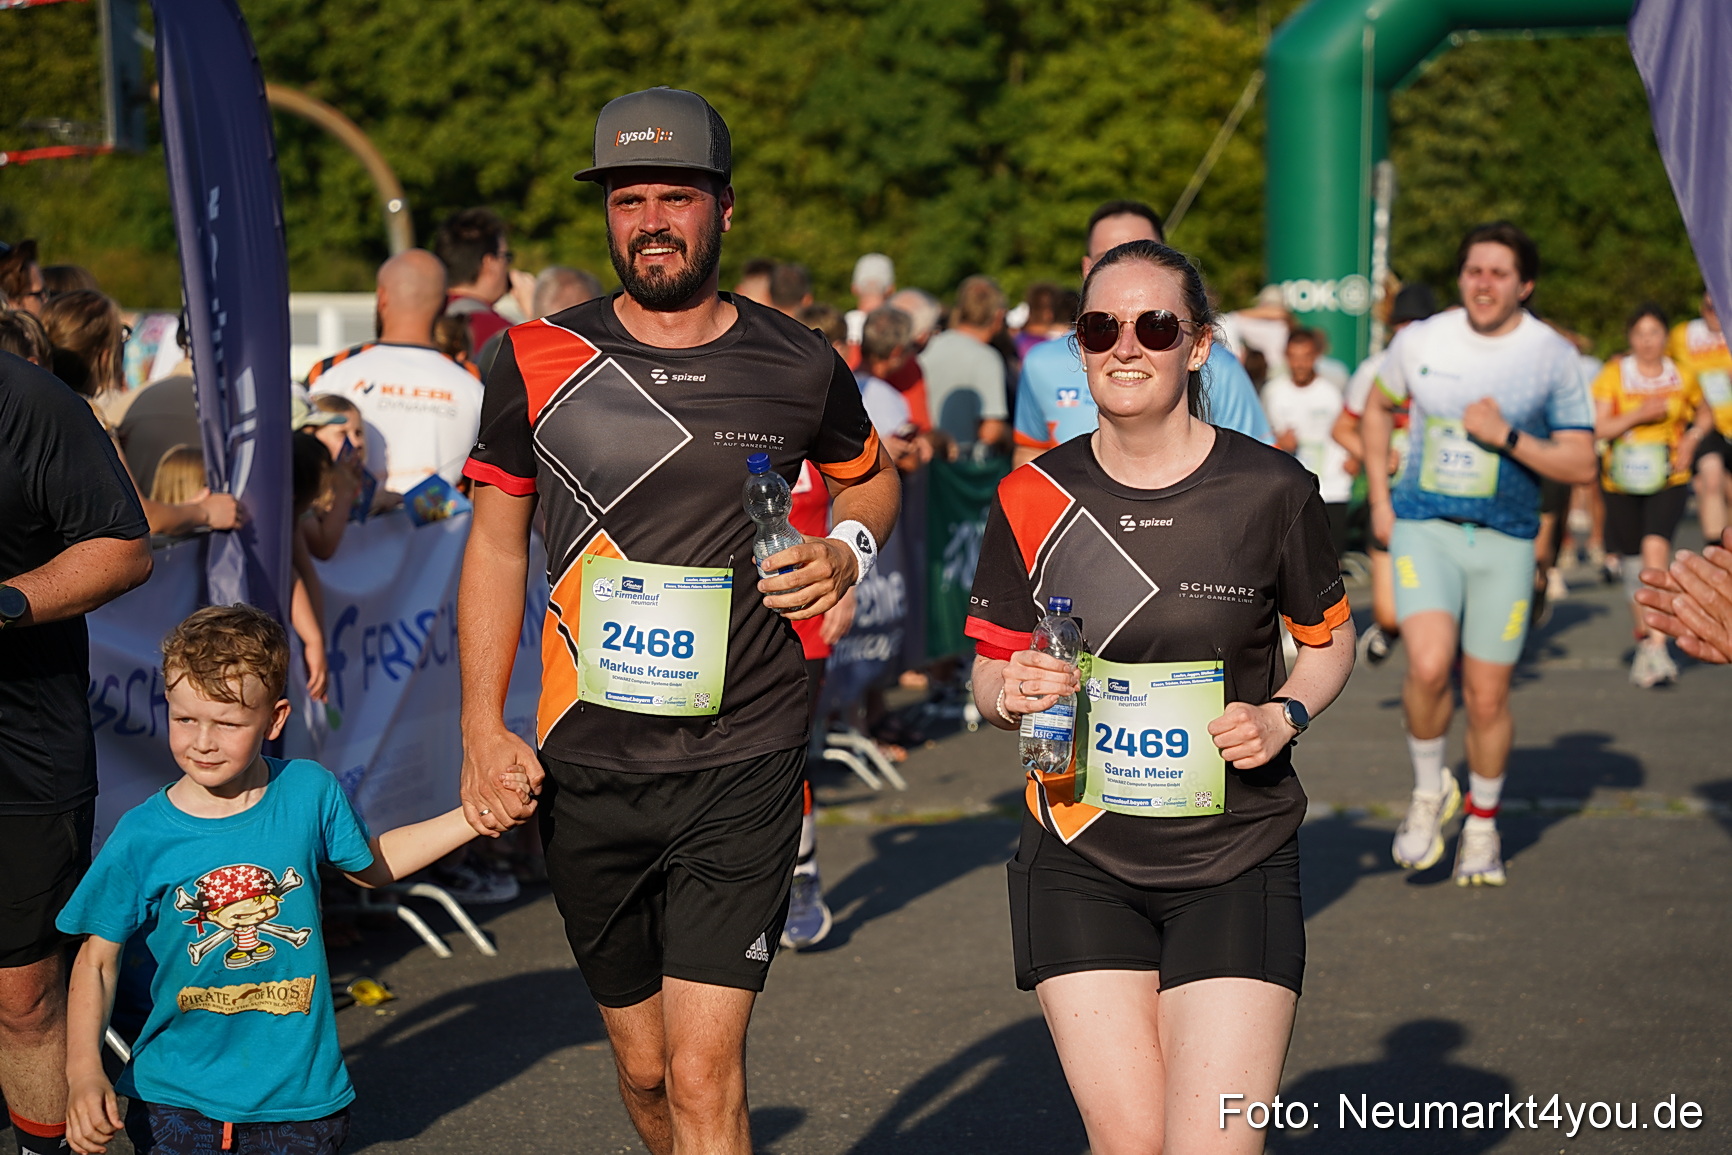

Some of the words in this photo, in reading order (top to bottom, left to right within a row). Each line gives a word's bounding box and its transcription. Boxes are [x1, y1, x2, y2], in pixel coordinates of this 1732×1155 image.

[671, 372, 706, 383] spized
[713, 430, 785, 445] SCHWARZ
[1138, 517, 1173, 528] spized
[614, 590, 660, 602] Firmenlauf
[1179, 582, 1255, 597] SCHWARZ
[1206, 594, 1236, 602] GANZER
[601, 621, 695, 659] 2468
[599, 657, 644, 676] Markus
[647, 665, 699, 680] Krauser
[1102, 691, 1148, 702] Firmenlauf
[1095, 722, 1189, 759] 2469
[1104, 762, 1141, 779] Sarah
[1144, 767, 1184, 779] Meier
[745, 949, 769, 962] adidas
[180, 991, 231, 1006] PIRATE
[254, 990, 265, 1000] OF
